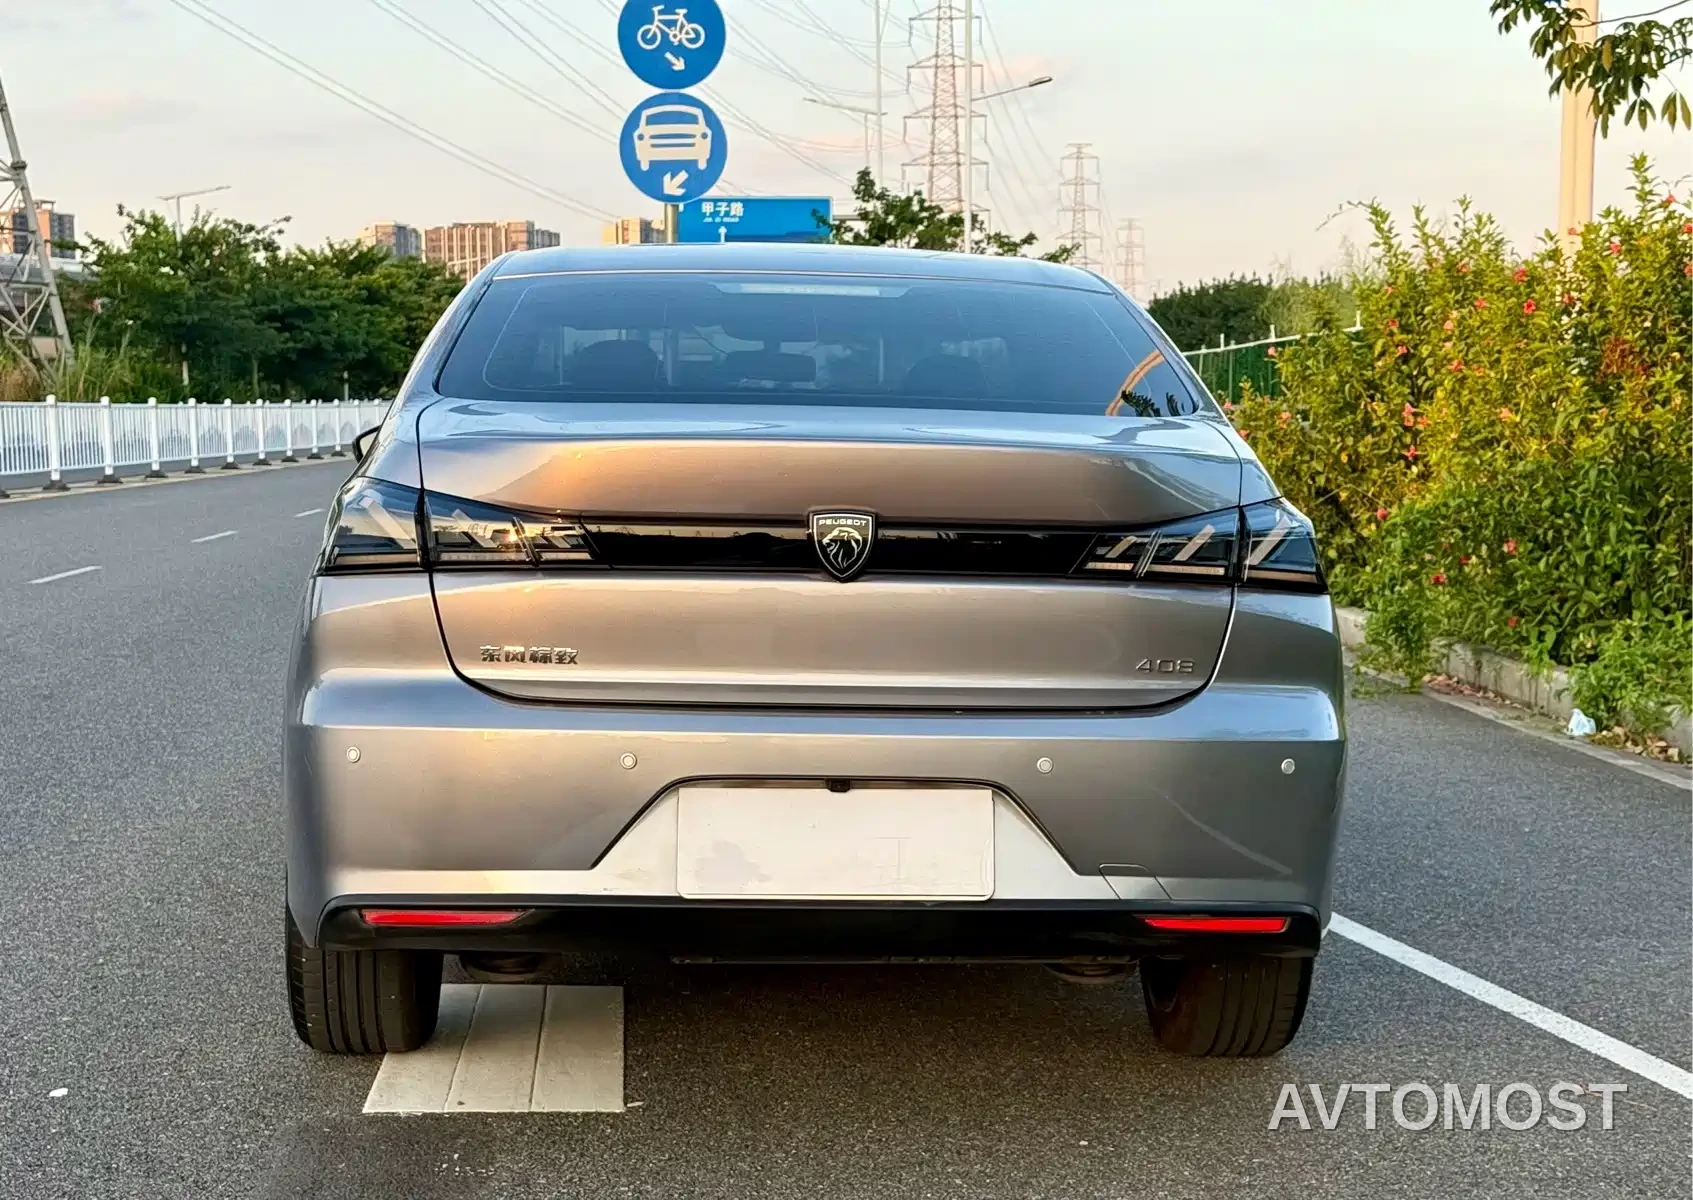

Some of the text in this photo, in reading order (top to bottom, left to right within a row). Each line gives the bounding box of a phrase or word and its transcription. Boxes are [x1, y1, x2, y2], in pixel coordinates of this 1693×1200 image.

[701, 201, 744, 217] 甲子路
[819, 518, 868, 527] PEUGEOT
[479, 645, 579, 665] 东风标致
[1135, 658, 1195, 674] 408
